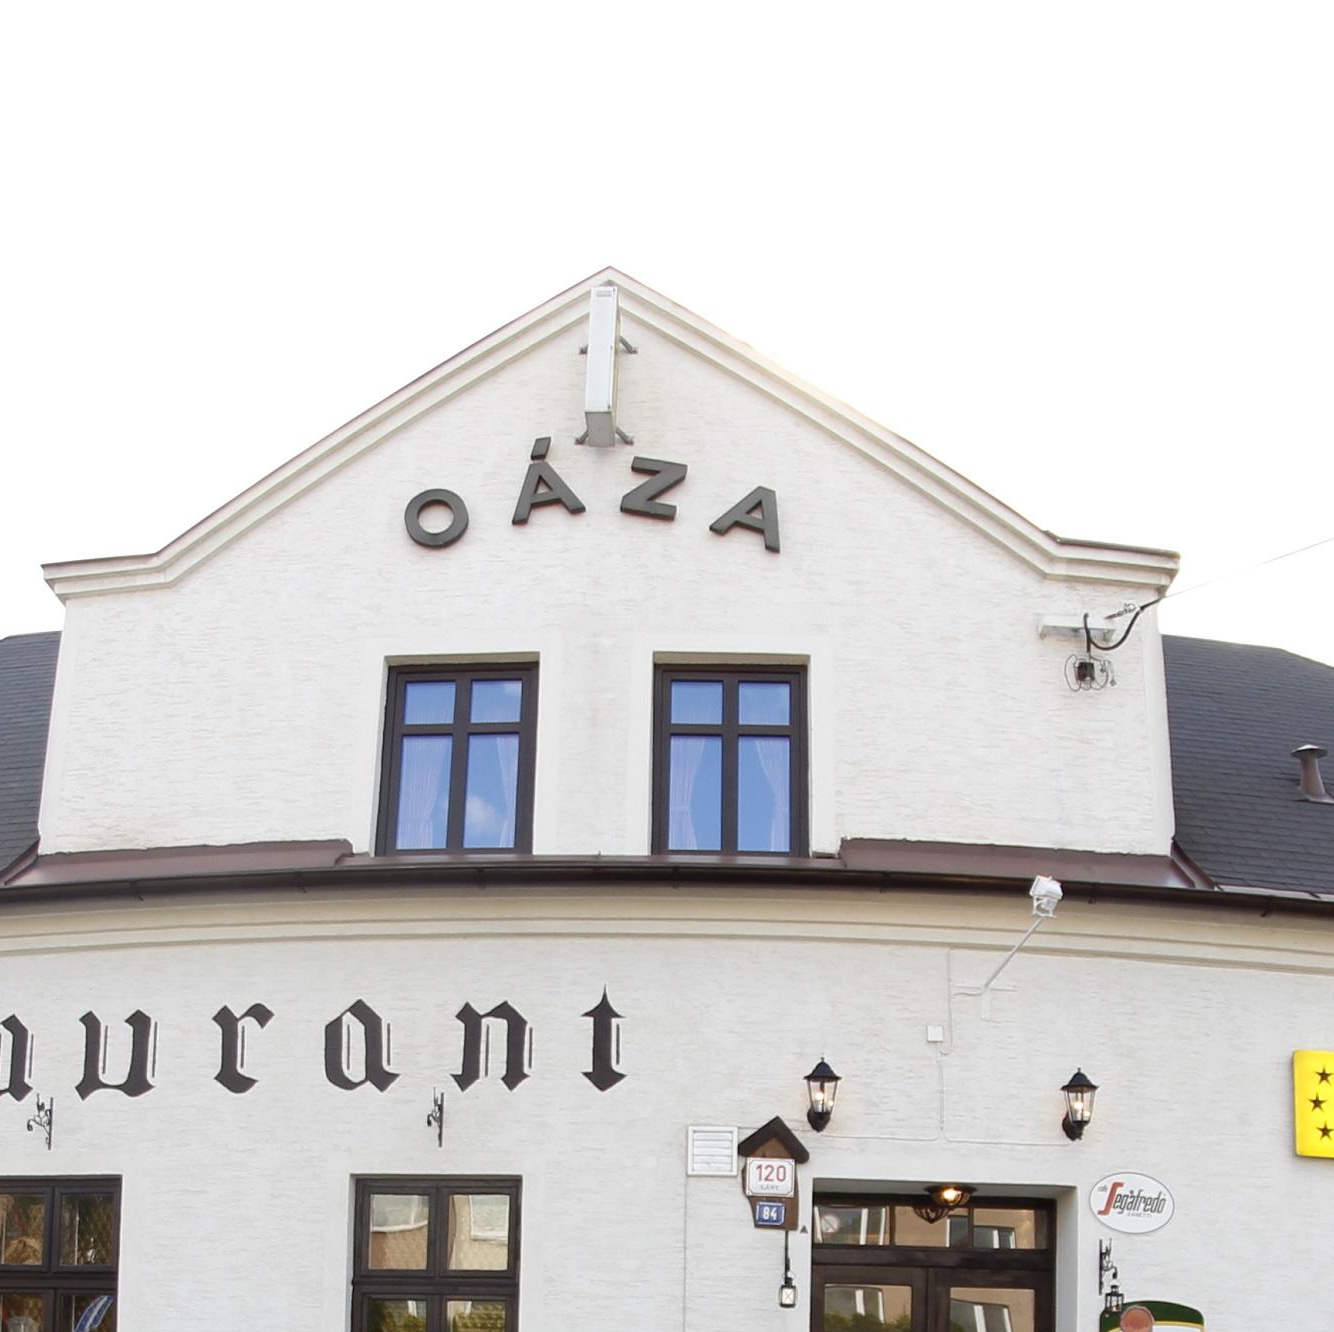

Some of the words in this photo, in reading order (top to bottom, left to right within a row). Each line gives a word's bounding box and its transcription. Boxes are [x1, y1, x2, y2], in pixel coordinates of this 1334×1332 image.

[404, 436, 781, 553] OÁZA
[756, 1164, 787, 1182] 120
[763, 1206, 777, 1220] 84
